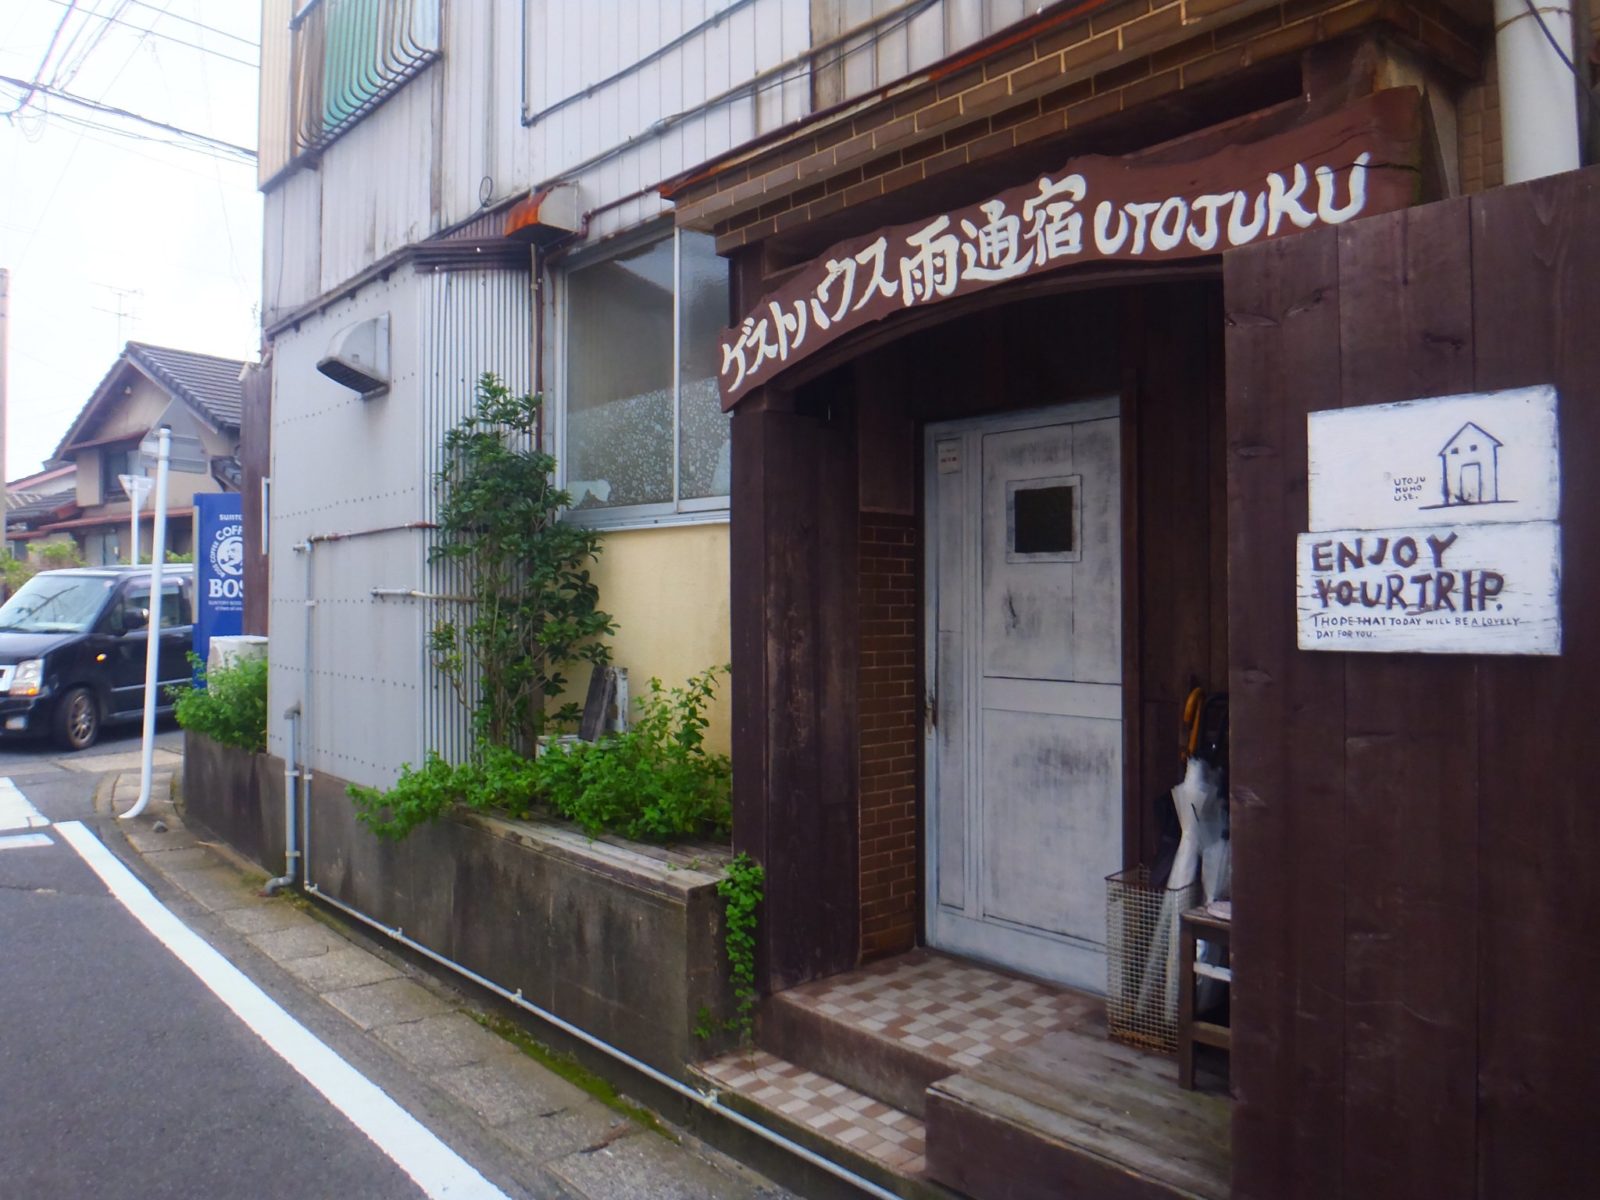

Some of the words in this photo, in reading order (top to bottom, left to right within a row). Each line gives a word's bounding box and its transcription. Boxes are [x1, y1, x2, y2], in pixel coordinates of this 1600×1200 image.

[1094, 152, 1371, 255] UTOJUKU
[1394, 476, 1426, 486] UTOJU
[1311, 531, 1458, 573] ENJOY
[1313, 573, 1407, 610] YOUR
[1410, 570, 1504, 612] TRIP.
[1316, 630, 1333, 639] DAY
[1338, 629, 1352, 638] FOR
[1356, 630, 1377, 638] YOU.
[1321, 616, 1353, 626] HOPE
[1357, 616, 1386, 626] THAT
[1390, 616, 1420, 626] TODAY
[1455, 617, 1469, 625] BE
[1471, 617, 1478, 625] A
[1482, 616, 1520, 627] LOVELY
